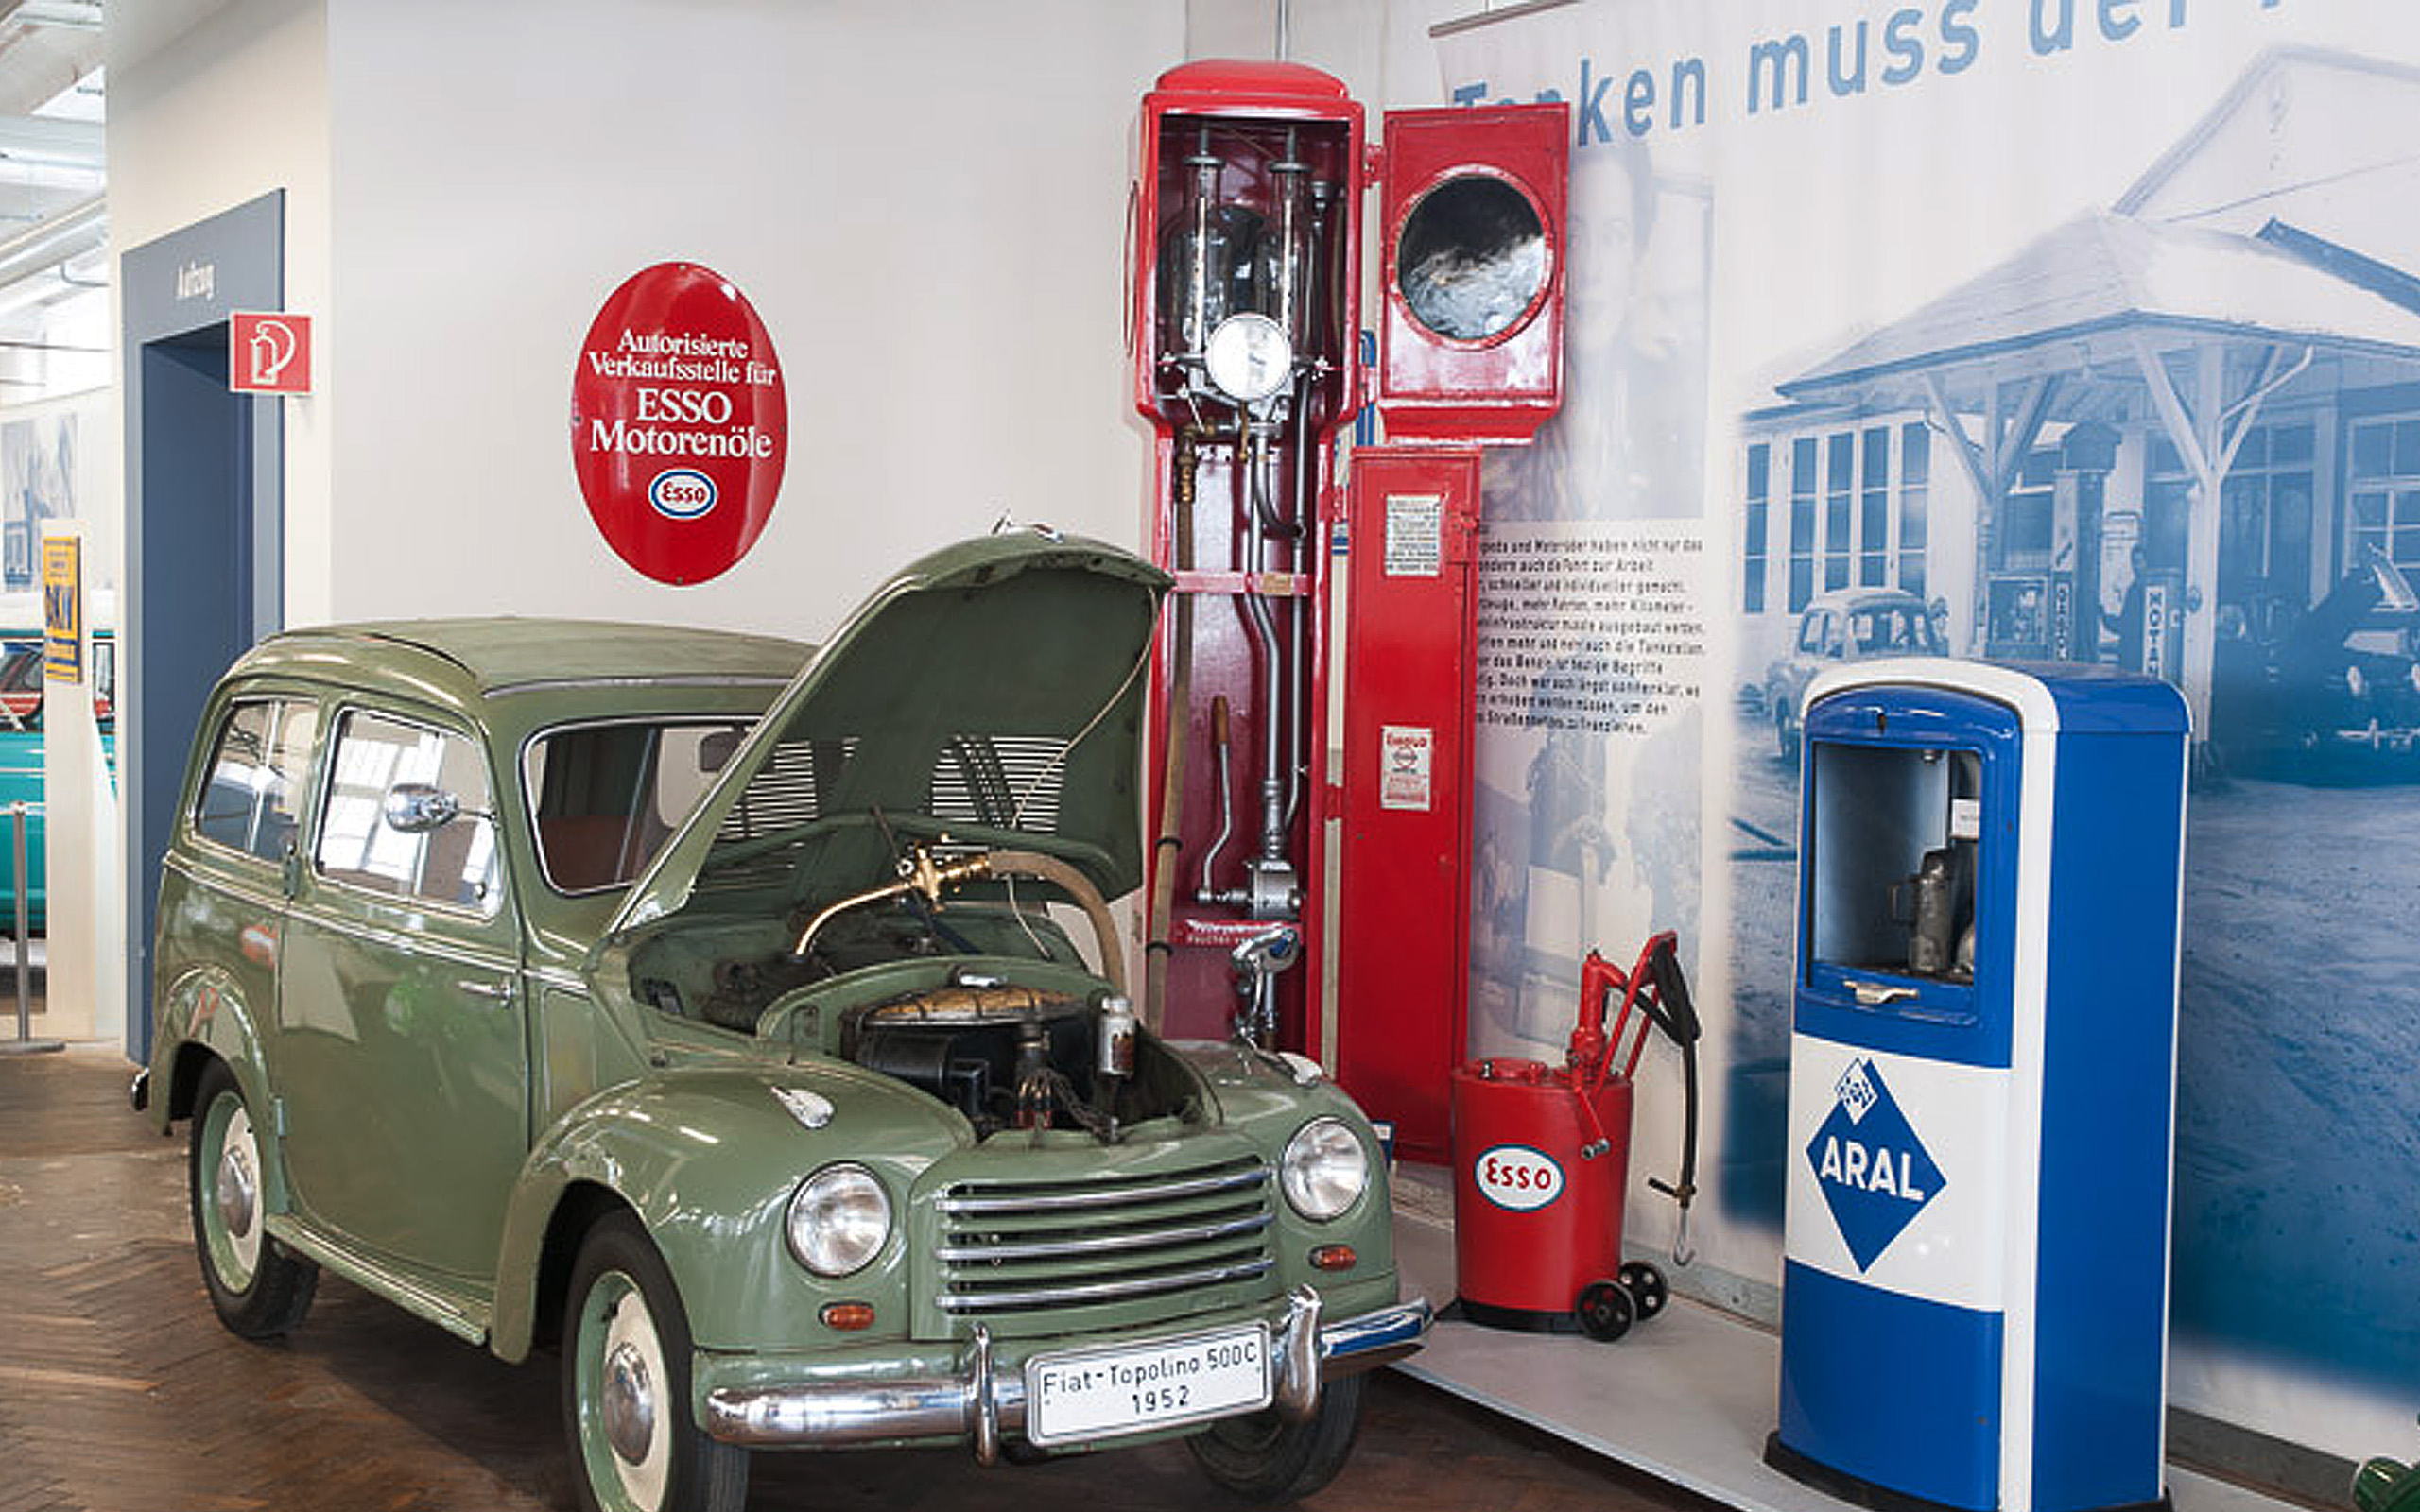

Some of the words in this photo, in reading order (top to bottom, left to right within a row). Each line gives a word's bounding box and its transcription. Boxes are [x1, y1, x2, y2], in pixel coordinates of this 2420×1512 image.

[1454, 57, 1705, 147] ken
[1747, 0, 1979, 113] muss
[617, 329, 749, 359] Autorisierte
[589, 351, 740, 384] Verkaufsstelle
[745, 361, 777, 386] für
[636, 388, 733, 424] ESSO
[590, 419, 772, 459] Motorenöle
[1486, 1157, 1551, 1190] Esso
[1821, 1135, 1925, 1202] ARAL
[1043, 1355, 1201, 1396] Fiat-Topolino
[1206, 1341, 1258, 1370] 500C
[1132, 1384, 1191, 1415] 1952
